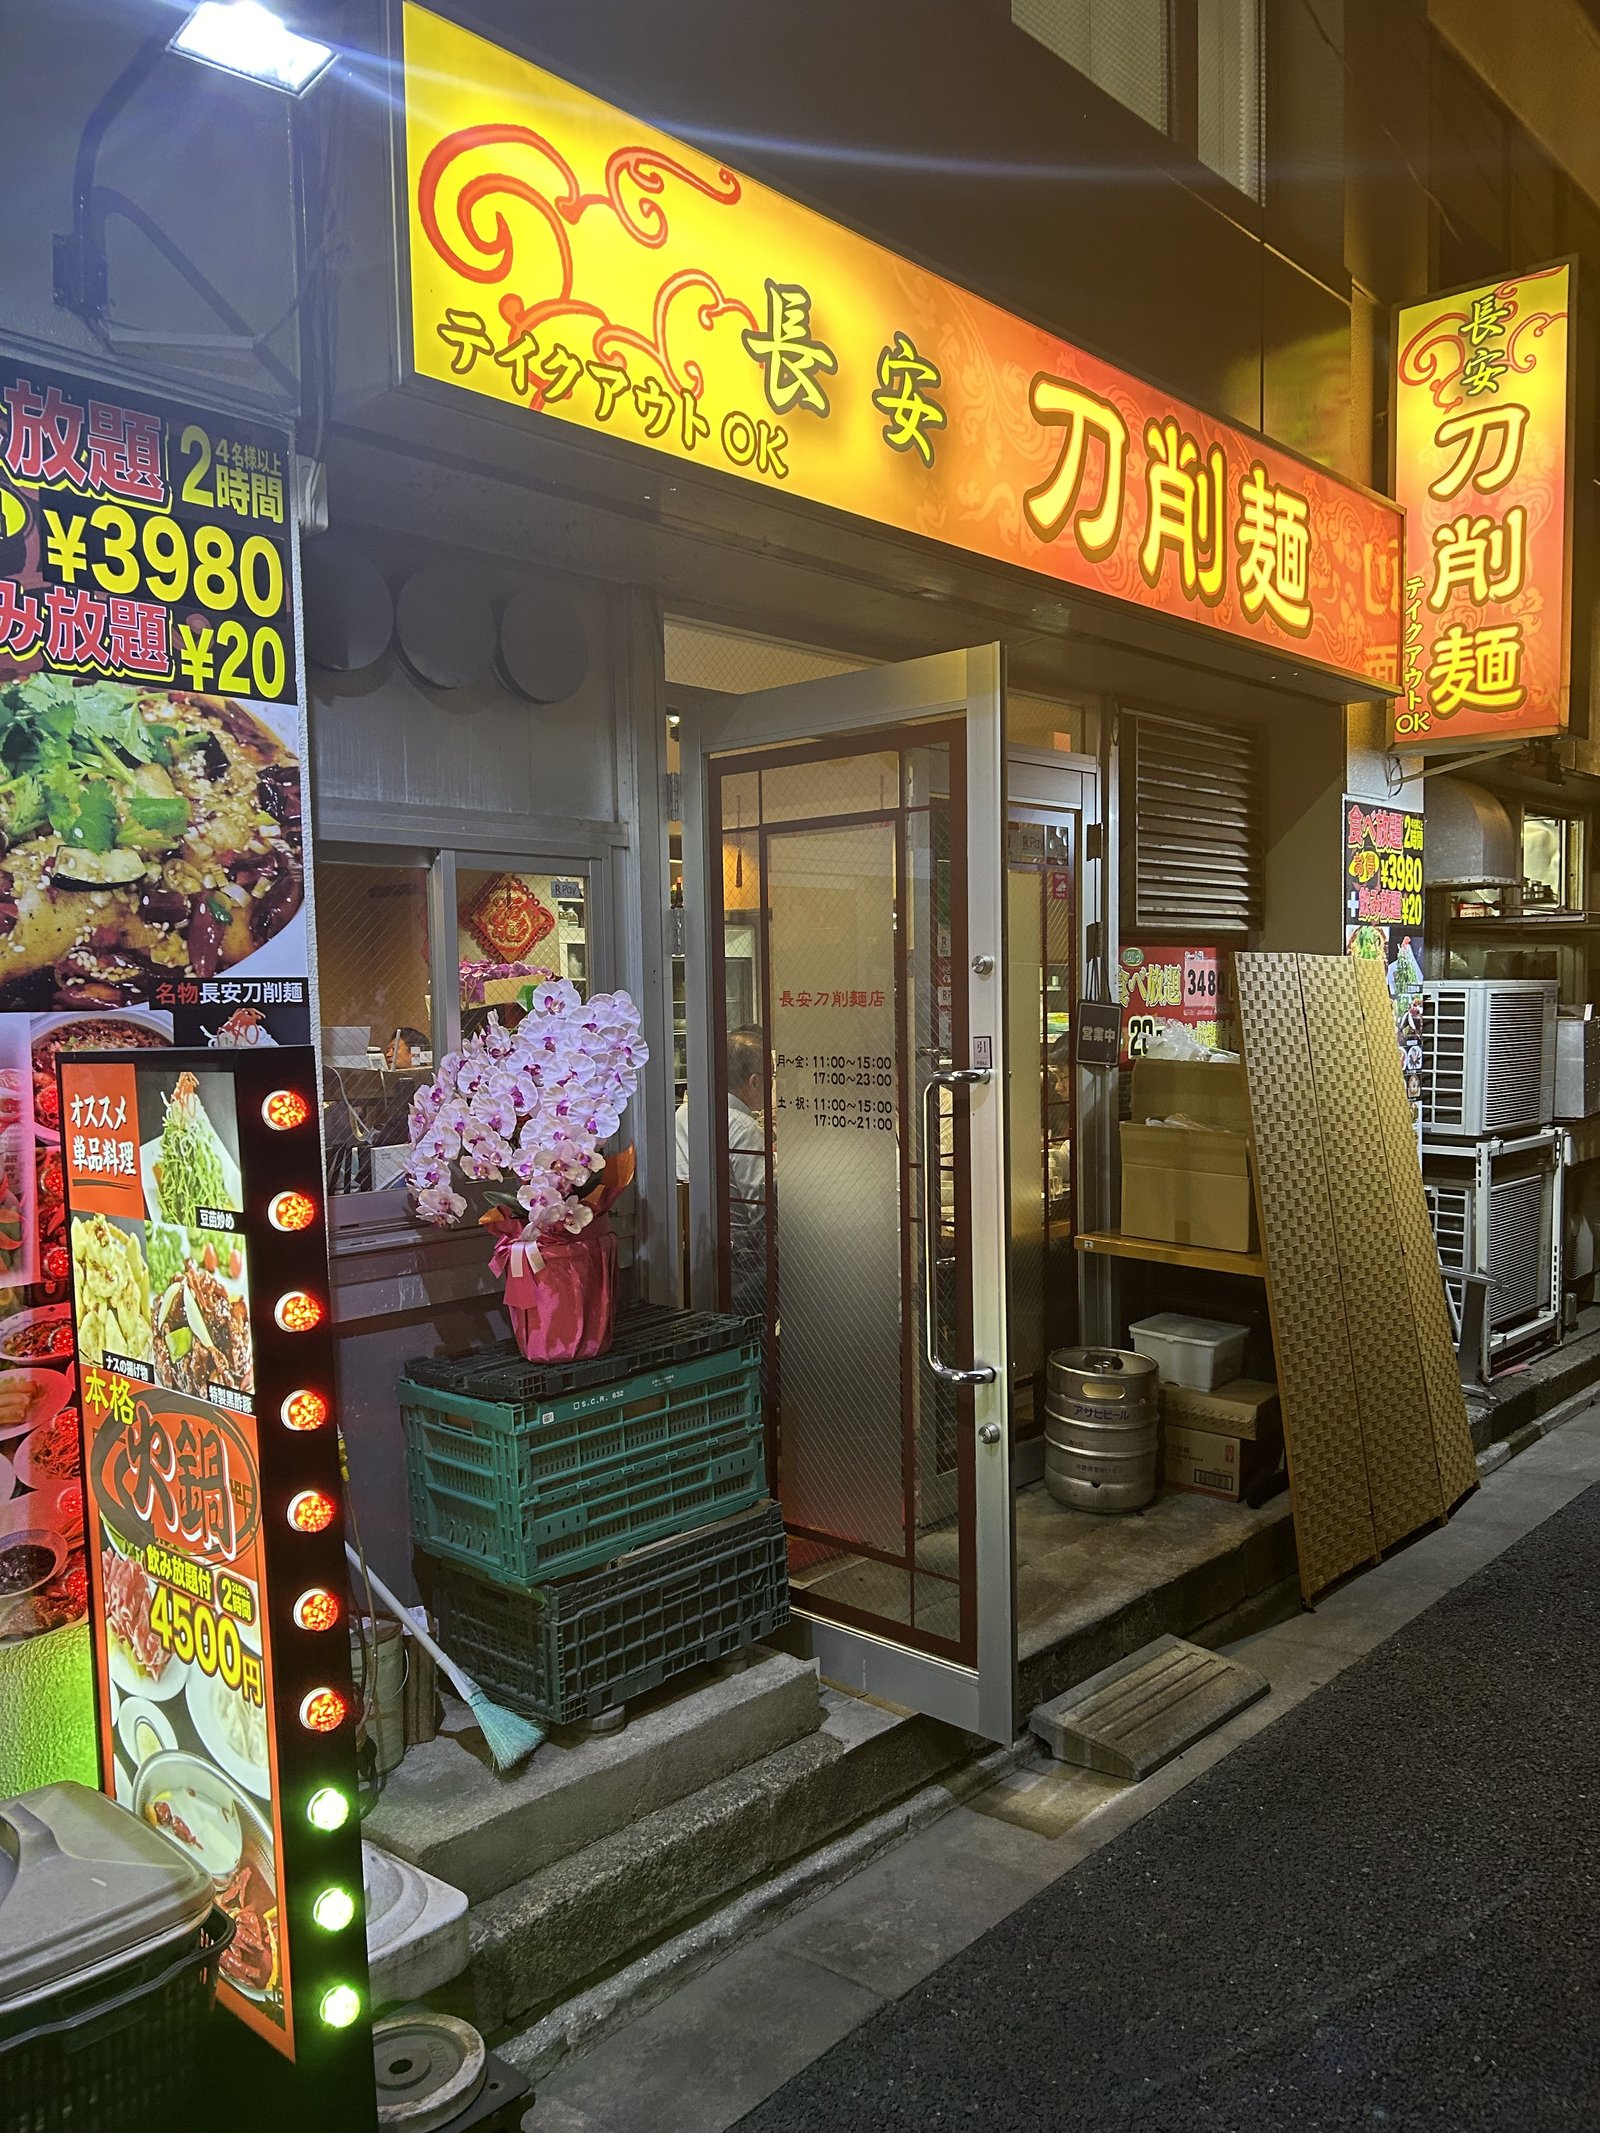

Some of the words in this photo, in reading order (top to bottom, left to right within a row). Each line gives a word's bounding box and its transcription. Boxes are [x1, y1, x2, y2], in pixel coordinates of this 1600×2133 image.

[1458, 293, 1510, 396] 長安
[437, 309, 710, 450] テイクアウト
[722, 412, 789, 477] OK
[0, 379, 165, 504] 放題
[742, 278, 946, 468] 長安
[1025, 371, 1313, 639] 刀削麺
[43, 505, 283, 617] ¥3980
[1427, 402, 1530, 718] 刀削麺
[178, 620, 285, 698] ¥20
[1405, 576, 1425, 711] テイクアウト
[1396, 712, 1430, 734] OK
[1348, 804, 1403, 850] 食べ放題
[1380, 854, 1422, 893] ¥3980
[1359, 887, 1402, 920] 飲み放題
[1402, 894, 1422, 925] ¥20
[156, 982, 303, 1005] 名物長安刀削麺
[977, 1041, 986, 1053] 引
[1082, 1026, 1116, 1043] 営業中
[70, 1094, 126, 1129] オススメ
[72, 1135, 137, 1176] 単品料理
[200, 1210, 234, 1230] 豆苗炒め
[106, 1355, 148, 1381] ナスの揚げ物
[85, 1369, 135, 1425] 本格
[1074, 1405, 1130, 1420] アサヒビール
[127, 1401, 236, 1560] 火鍋
[147, 1544, 211, 1600] 飲み放題付
[151, 1585, 262, 1707] 4500円
